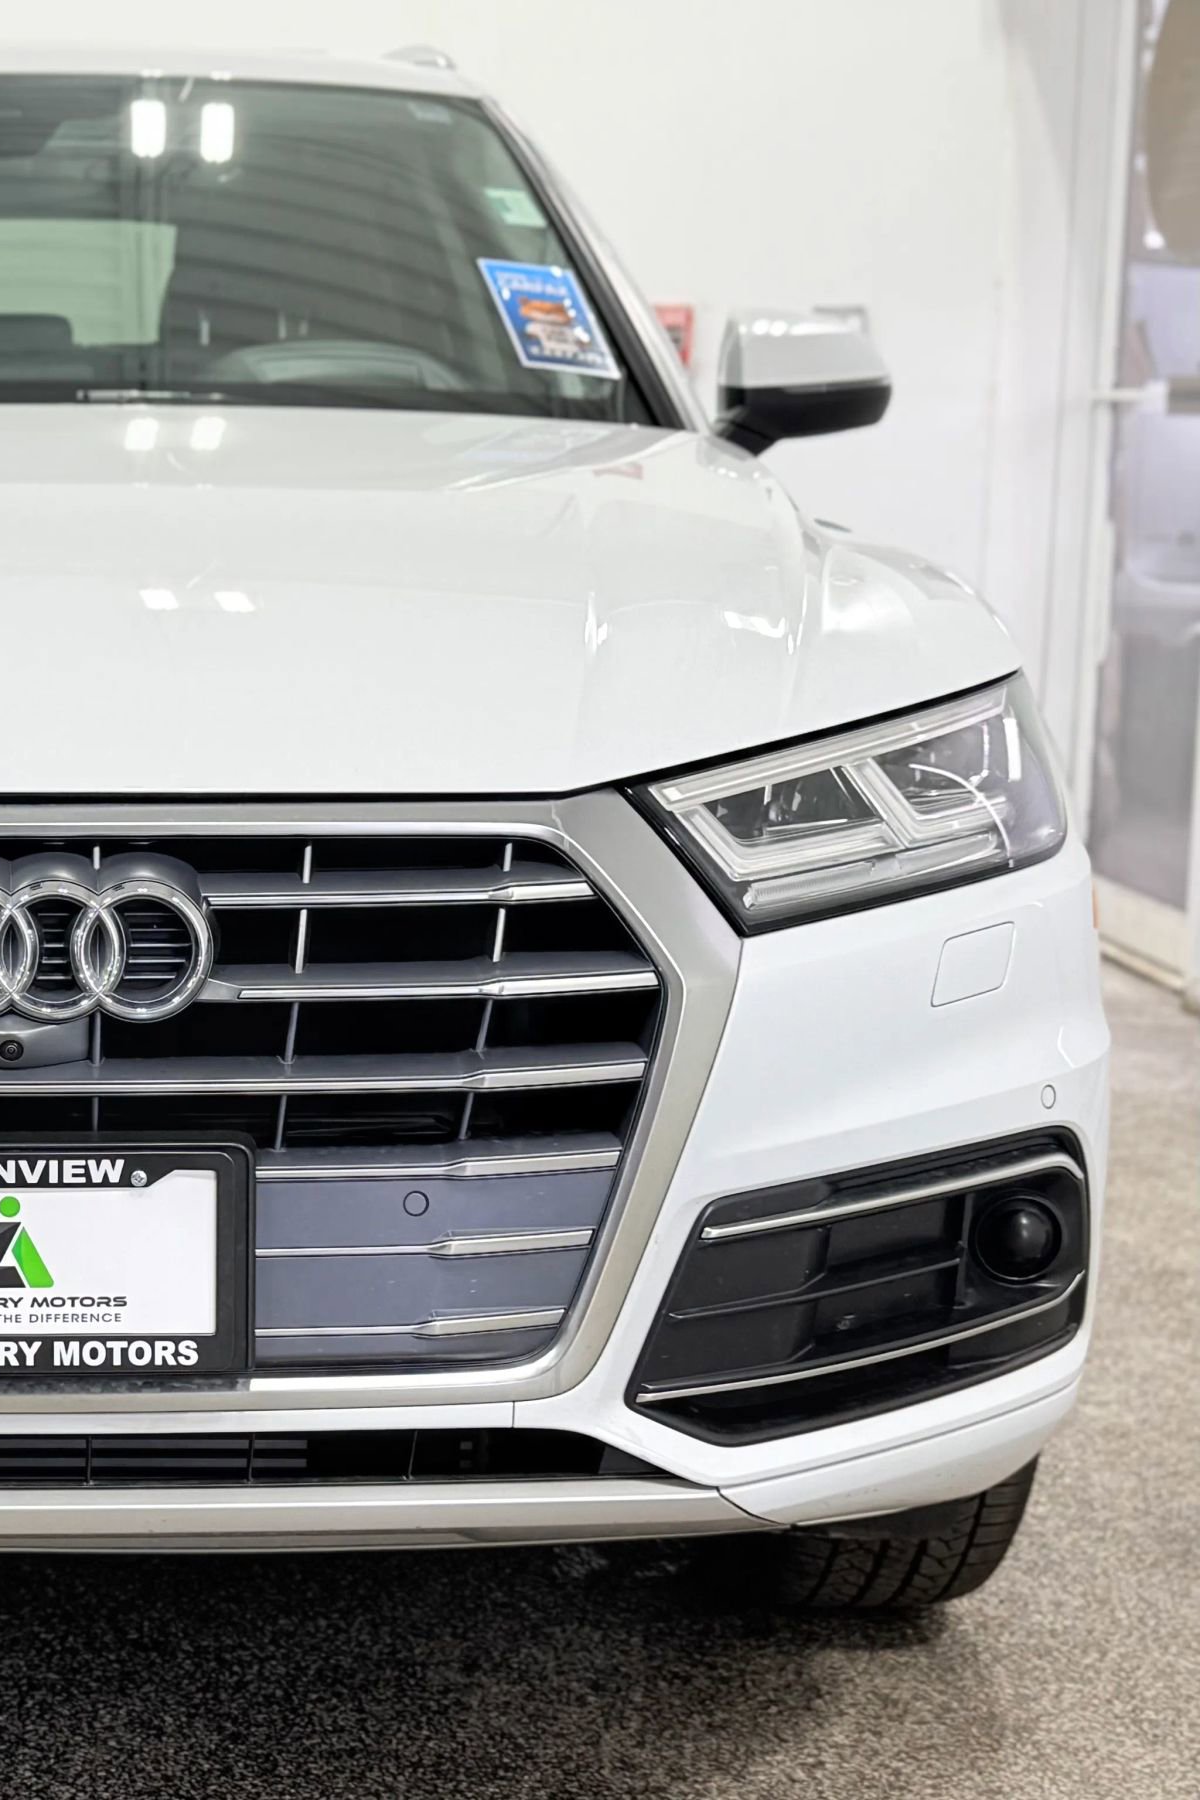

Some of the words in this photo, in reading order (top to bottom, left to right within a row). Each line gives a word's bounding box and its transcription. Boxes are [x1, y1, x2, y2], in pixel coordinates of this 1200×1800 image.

[30, 1296, 128, 1308] MOTORS
[29, 1312, 122, 1324] DIFFERENCE
[53, 1339, 200, 1367] MOTORS
